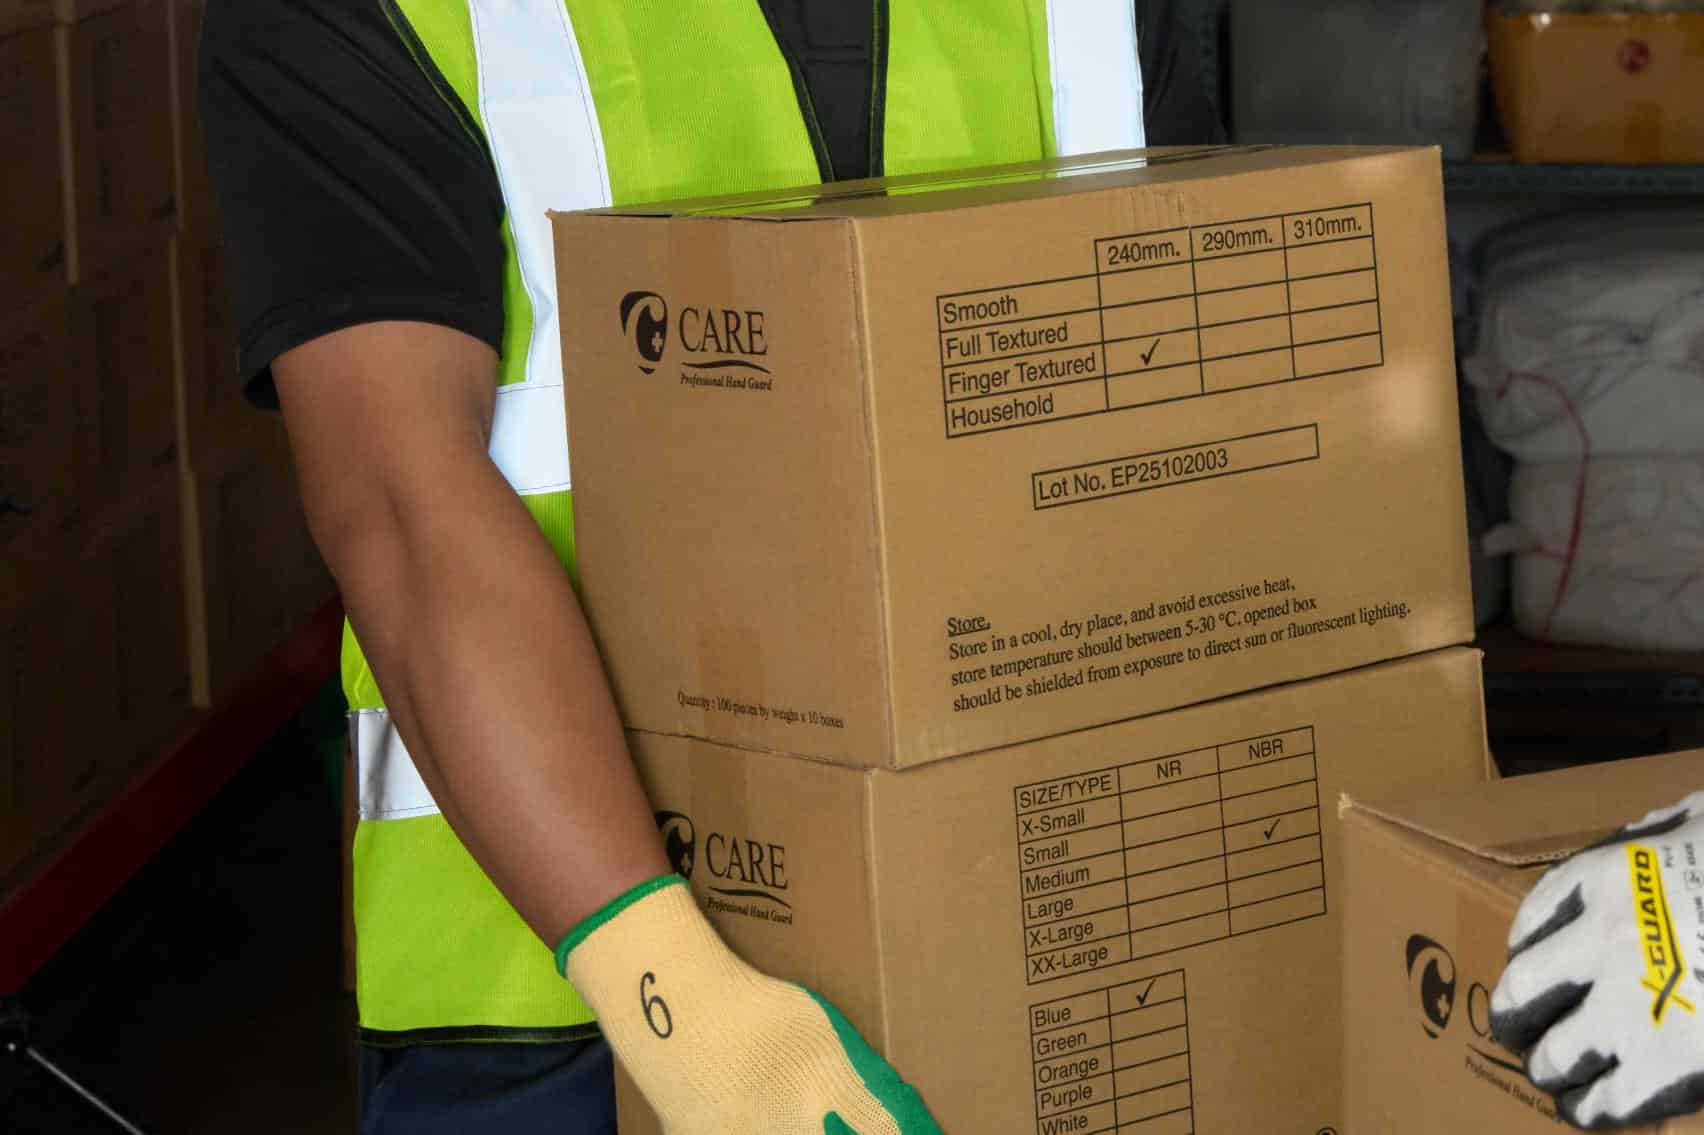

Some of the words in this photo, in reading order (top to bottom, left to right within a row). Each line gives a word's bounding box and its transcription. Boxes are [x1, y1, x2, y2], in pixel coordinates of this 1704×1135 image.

[1107, 242, 1181, 266] 240mm.
[1201, 227, 1273, 253] 290mm.
[1293, 214, 1363, 240] 310mm.
[943, 295, 1018, 325] Smooth
[679, 306, 768, 355] CARE
[946, 334, 981, 360] Full
[985, 322, 1069, 354] Textured
[680, 372, 724, 388] Professional
[726, 375, 746, 389] Hand
[747, 377, 772, 391] Guard
[949, 369, 1010, 397] Finger
[1014, 352, 1096, 383] Textured
[951, 394, 1054, 429] Household
[1038, 475, 1069, 501] Lot
[1074, 469, 1106, 494] No.
[1111, 448, 1228, 489] EP25102003
[949, 640, 988, 661] Store
[992, 635, 1005, 652] in
[1009, 637, 1018, 648] a
[1060, 620, 1082, 643] dry
[1130, 605, 1155, 625] and
[1158, 595, 1196, 617] avoid
[1199, 582, 1261, 609] excessive
[951, 667, 987, 686] store
[990, 646, 1074, 680] temperature
[1078, 633, 1123, 657] should
[1126, 624, 1182, 650] between
[1185, 615, 1216, 636] 5-30
[1244, 600, 1290, 627] opened
[1293, 596, 1317, 614] box
[953, 685, 1001, 713] should
[1005, 680, 1023, 701] be
[1026, 670, 1084, 696] shielded
[1087, 663, 1120, 683] from
[1124, 647, 1184, 677] exposure
[1187, 644, 1200, 660] to
[1203, 633, 1242, 658] direct
[1245, 632, 1267, 650] sun
[1270, 628, 1284, 643] or
[1287, 612, 1356, 639] fluorescent
[1156, 759, 1182, 780] NR
[1248, 738, 1283, 760] NBR
[1019, 774, 1111, 809] SIZE/TYPE
[1022, 808, 1085, 836] X-Small
[705, 832, 788, 890] CARE
[1024, 840, 1069, 865] Small
[1026, 865, 1089, 893] Medium
[706, 896, 748, 915] Professional
[750, 905, 769, 920] Hand
[1027, 897, 1073, 921] Large
[1029, 920, 1094, 948] X-Large
[1031, 944, 1108, 976] XX-Large
[1035, 1005, 1071, 1028] Blue
[1037, 1030, 1087, 1056] Green
[1038, 1055, 1099, 1084] Orange
[1040, 1083, 1093, 1110] Purple
[1042, 1115, 1088, 1135] White
